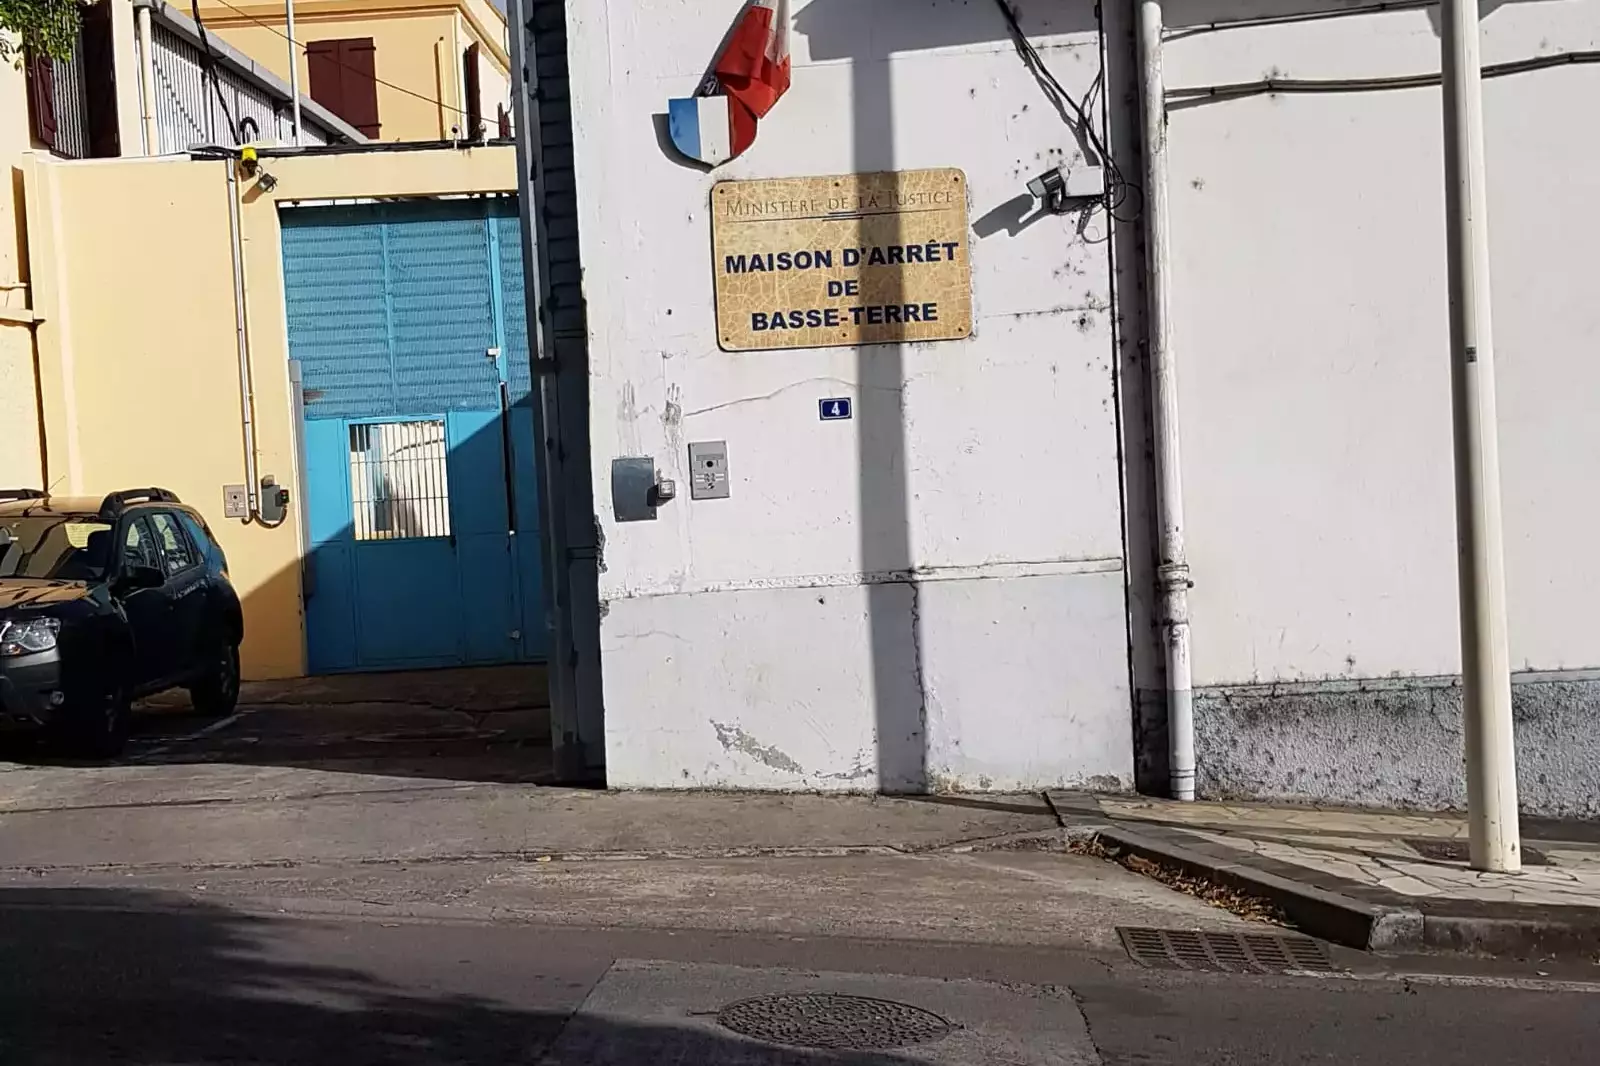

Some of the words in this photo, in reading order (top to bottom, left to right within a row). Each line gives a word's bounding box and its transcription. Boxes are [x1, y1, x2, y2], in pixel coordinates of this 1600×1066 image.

[828, 196, 849, 210] DE
[859, 193, 879, 209] LA
[887, 189, 953, 209] JUSTICE
[725, 249, 833, 274] MAISON
[843, 239, 959, 267] D'ARRÊT
[828, 279, 859, 298] DE
[751, 302, 938, 332] BASSE-TERRE
[831, 401, 841, 416] 4
